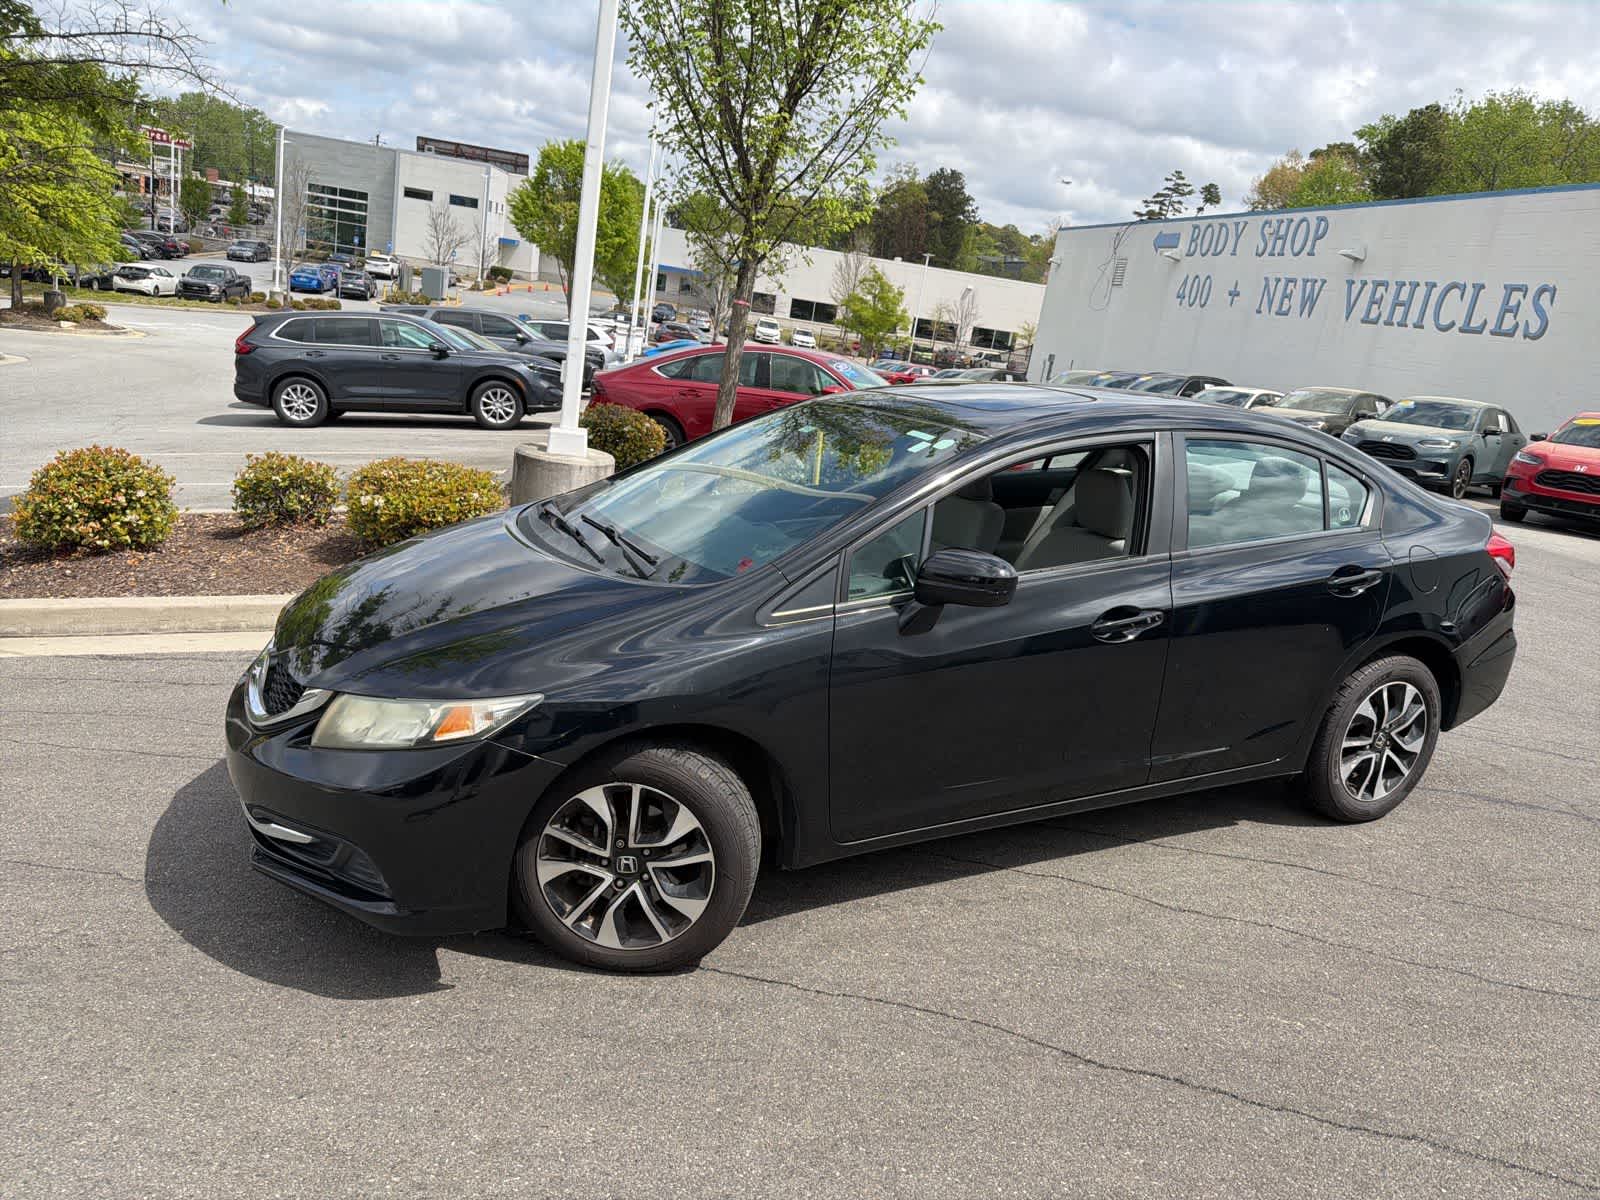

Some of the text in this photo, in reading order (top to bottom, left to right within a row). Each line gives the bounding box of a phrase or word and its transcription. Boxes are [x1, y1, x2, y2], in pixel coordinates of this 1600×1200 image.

[1185, 216, 1329, 257] BODY SHOP
[1176, 274, 1557, 341] 400 + NEW VEHICLES
